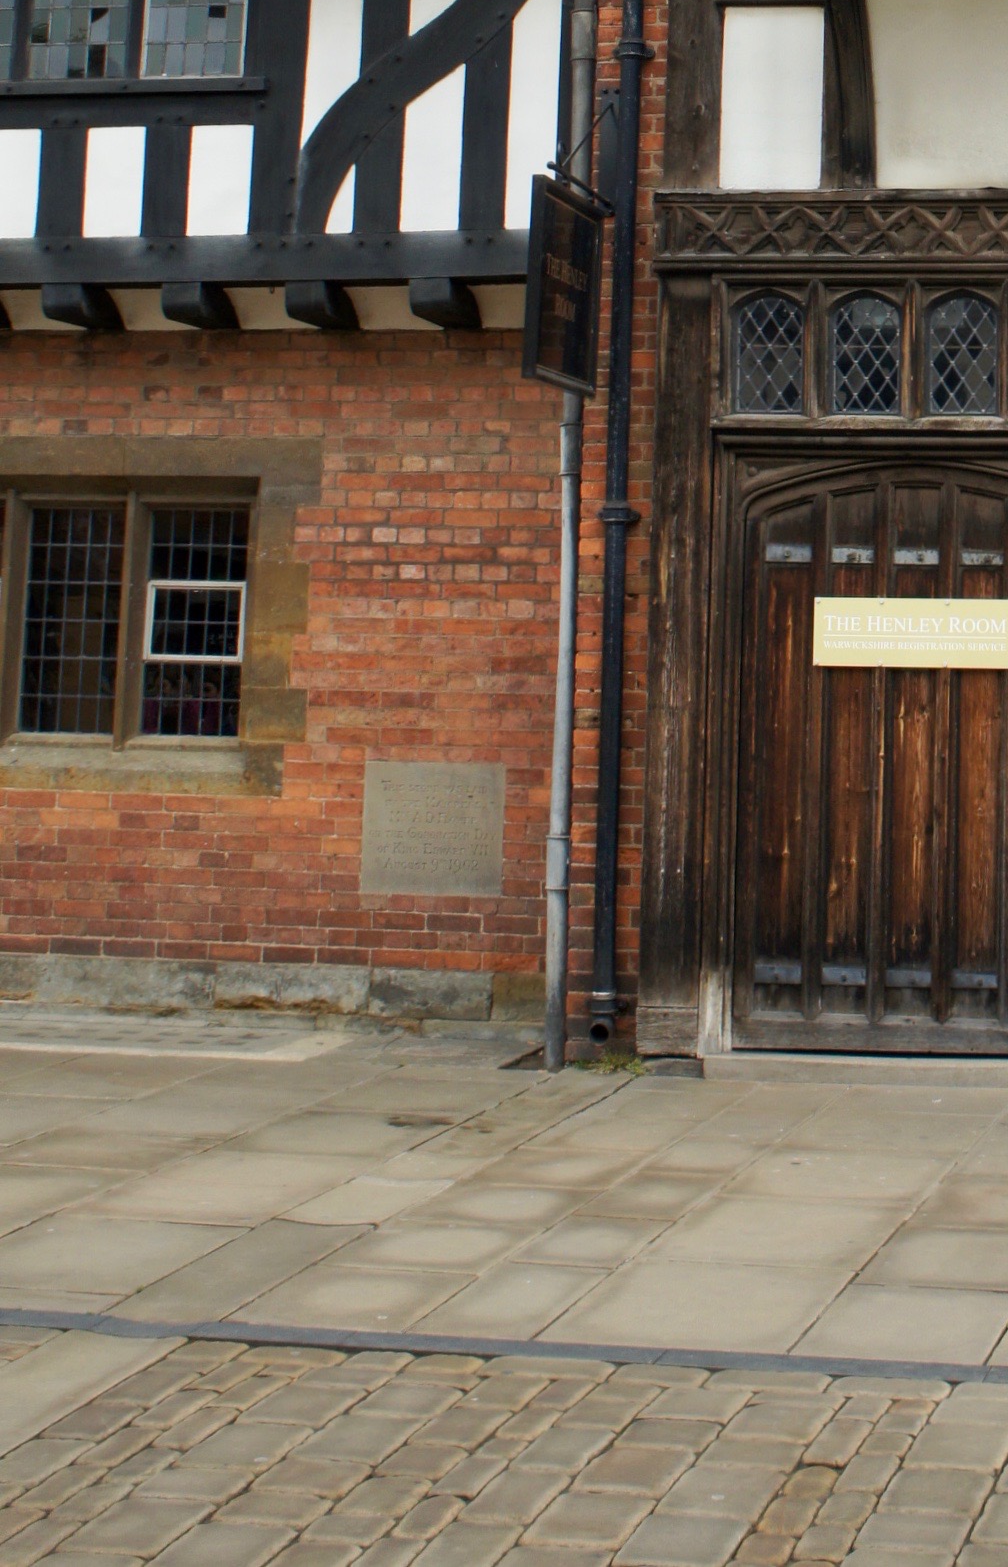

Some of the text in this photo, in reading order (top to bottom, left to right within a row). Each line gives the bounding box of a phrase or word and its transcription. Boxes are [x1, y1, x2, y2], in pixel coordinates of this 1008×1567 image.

[823, 615, 1007, 634] THE HENLEY ROOM
[823, 640, 1007, 652] WARWICKSHIRE REGISTRATION SERVICE
